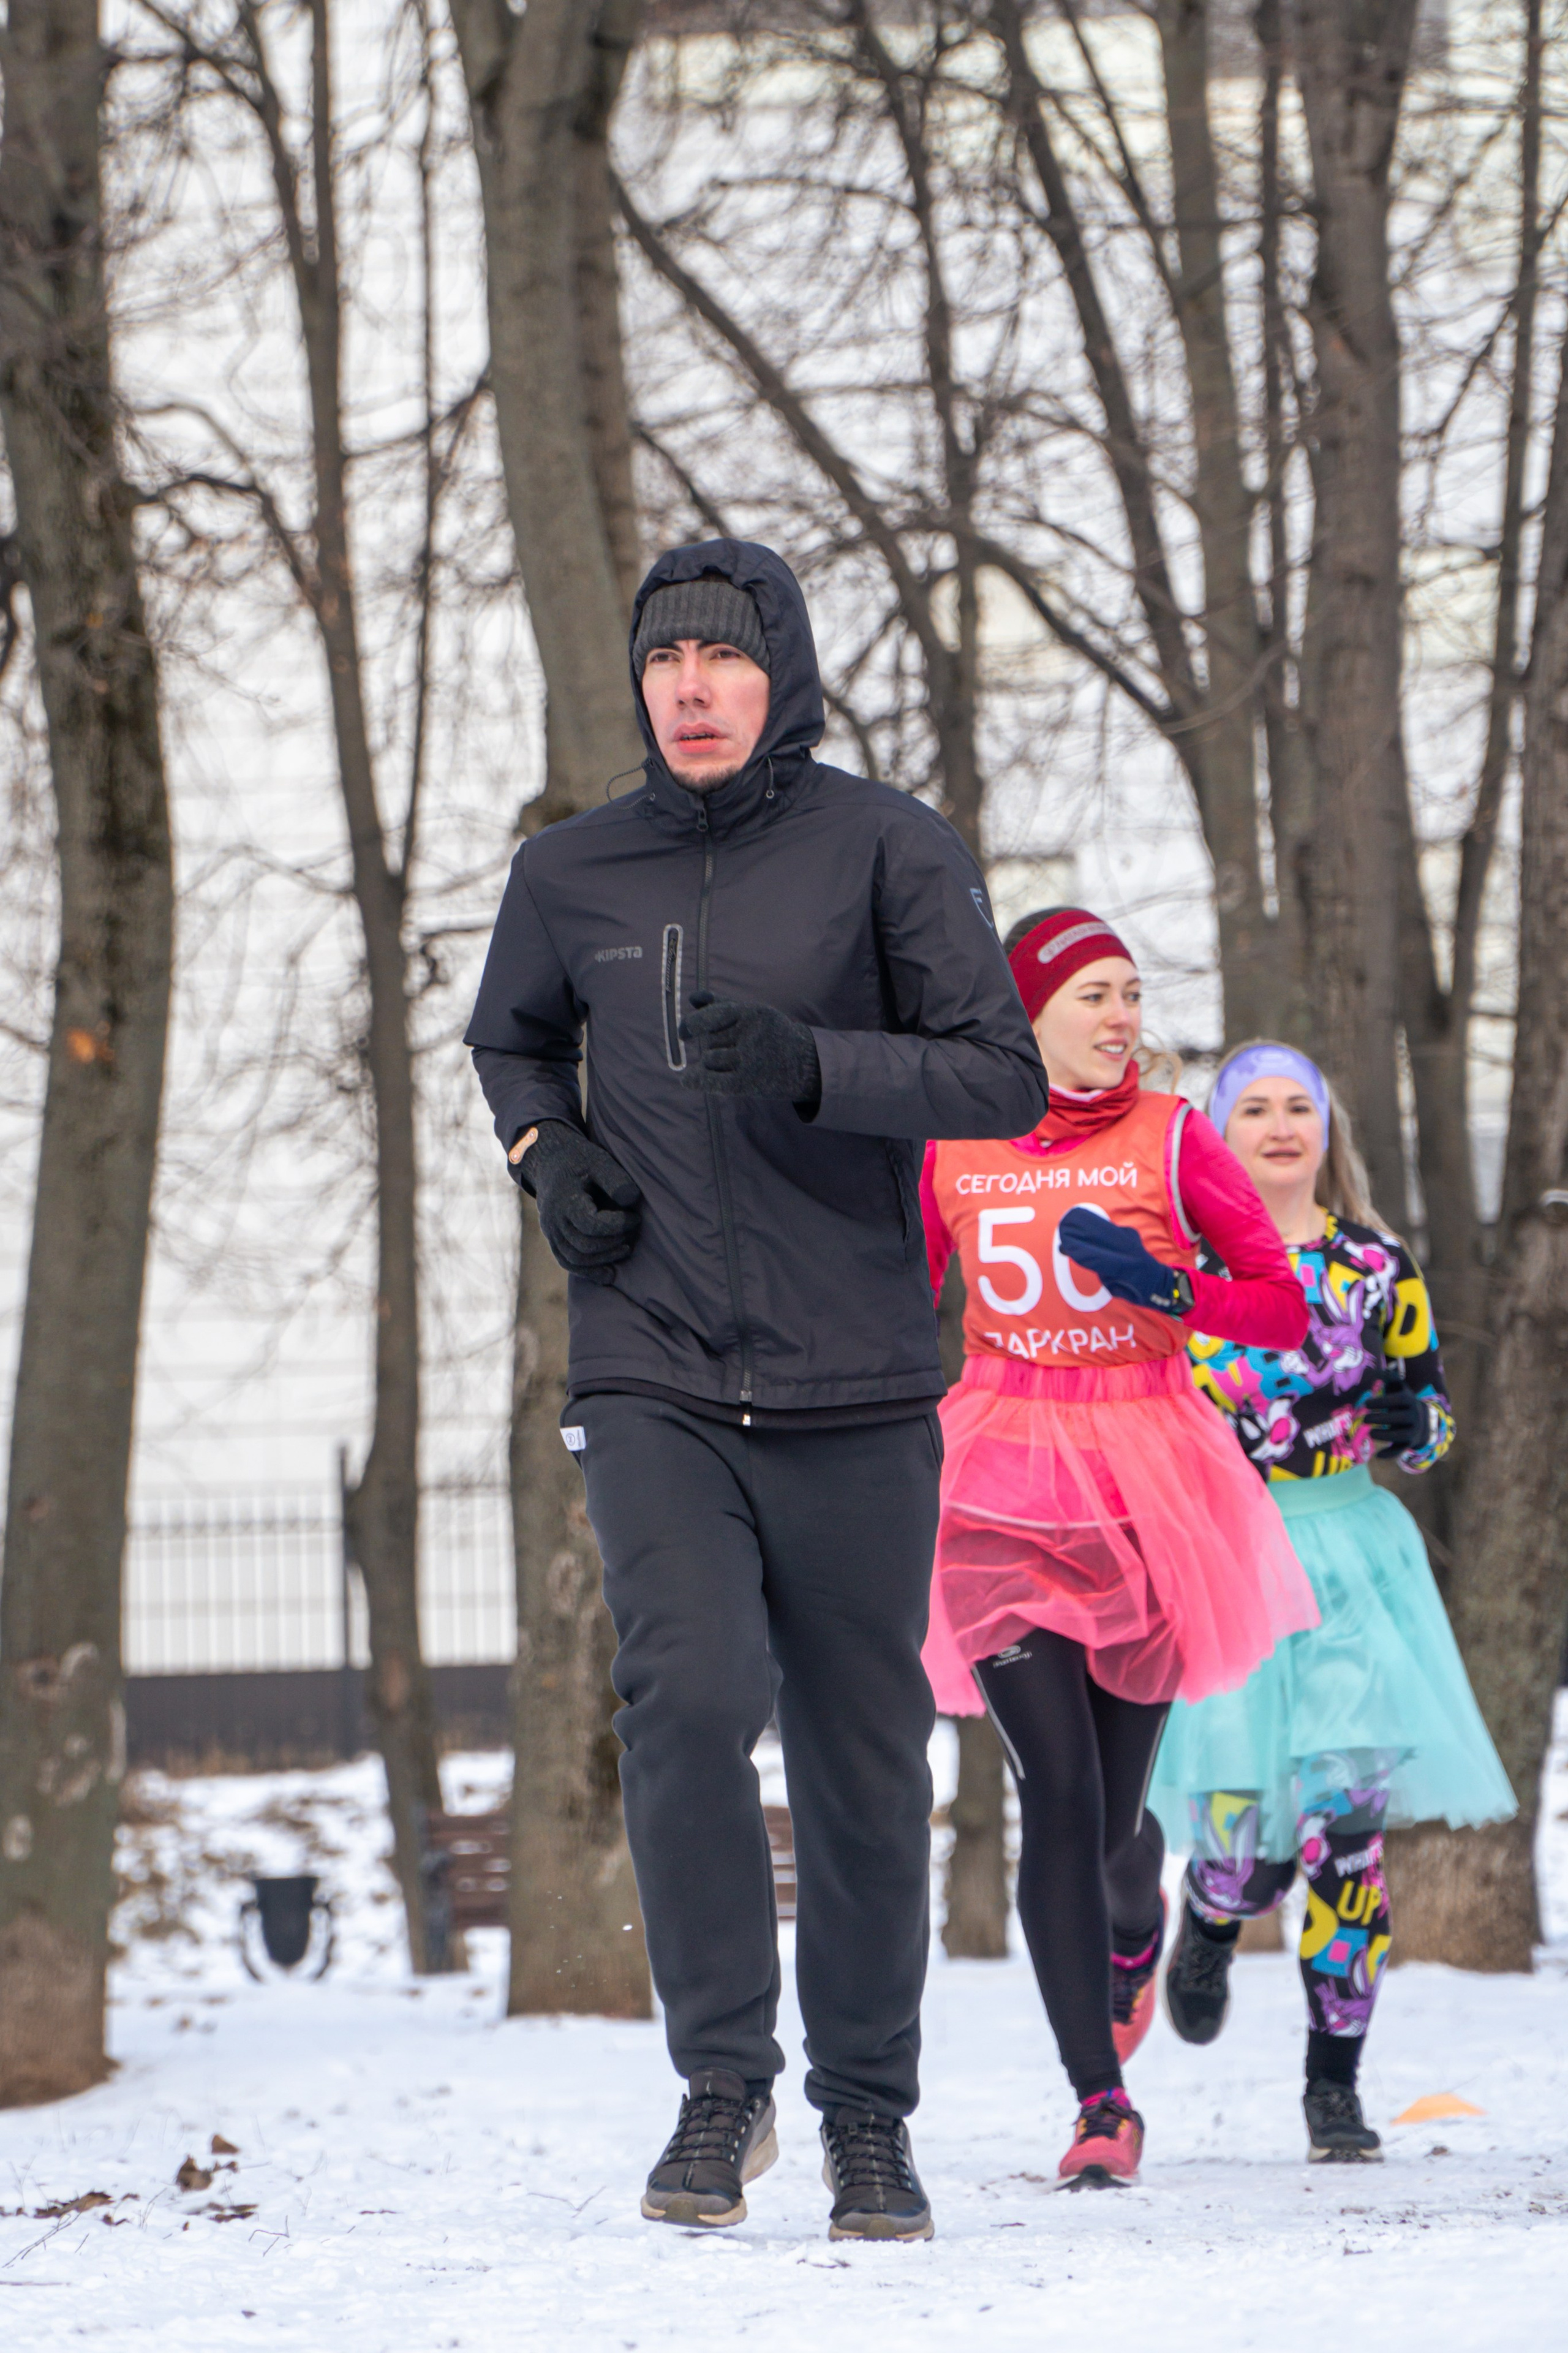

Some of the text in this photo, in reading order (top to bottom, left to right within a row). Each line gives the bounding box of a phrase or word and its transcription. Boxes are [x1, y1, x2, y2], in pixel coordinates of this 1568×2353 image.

[956, 1161, 1137, 1195] СЕГОДНЯ МОЙ
[1336, 1879, 1382, 1926] UP
